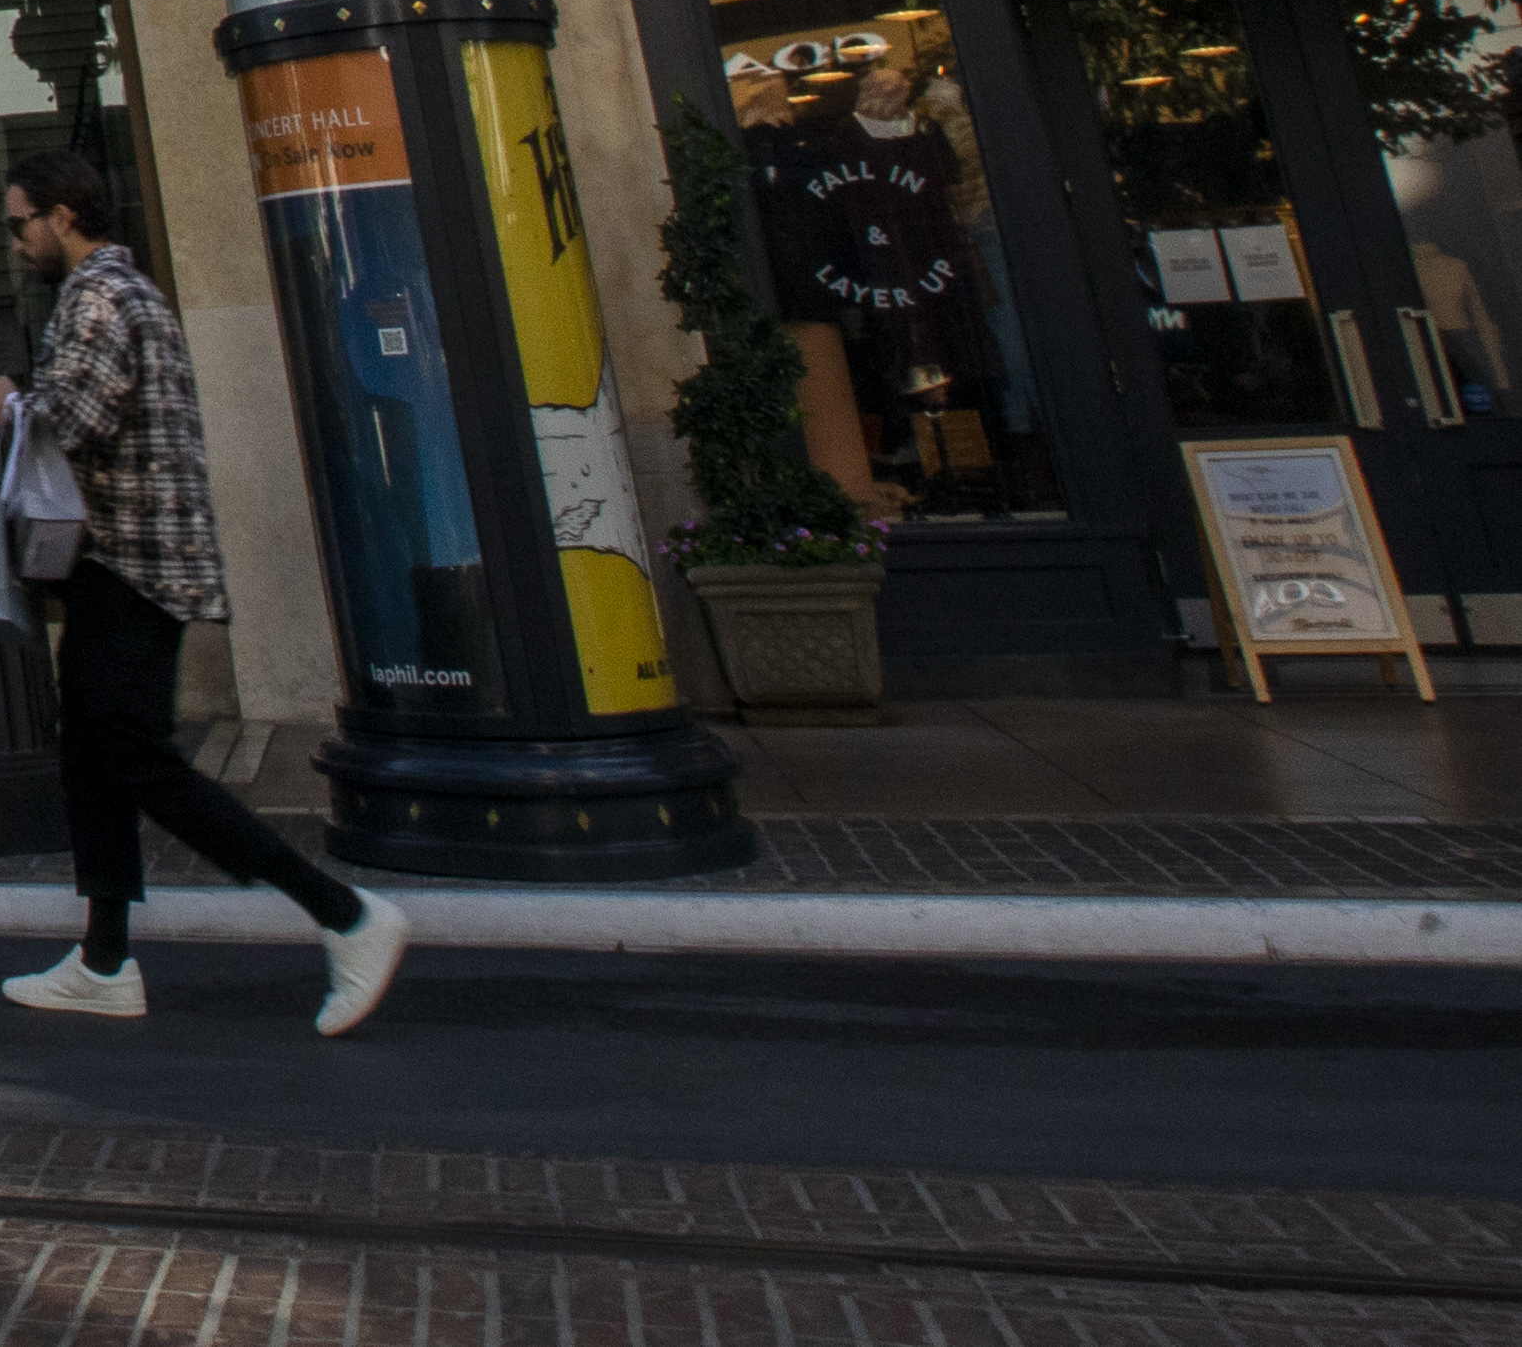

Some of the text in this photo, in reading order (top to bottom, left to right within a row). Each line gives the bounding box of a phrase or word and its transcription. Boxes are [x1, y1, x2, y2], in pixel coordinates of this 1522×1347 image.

[312, 106, 371, 130] HALL
[806, 161, 926, 199] FALL IN
[868, 225, 889, 245] &
[815, 259, 954, 308] LAYER UP
[370, 663, 471, 687] laphil.com
